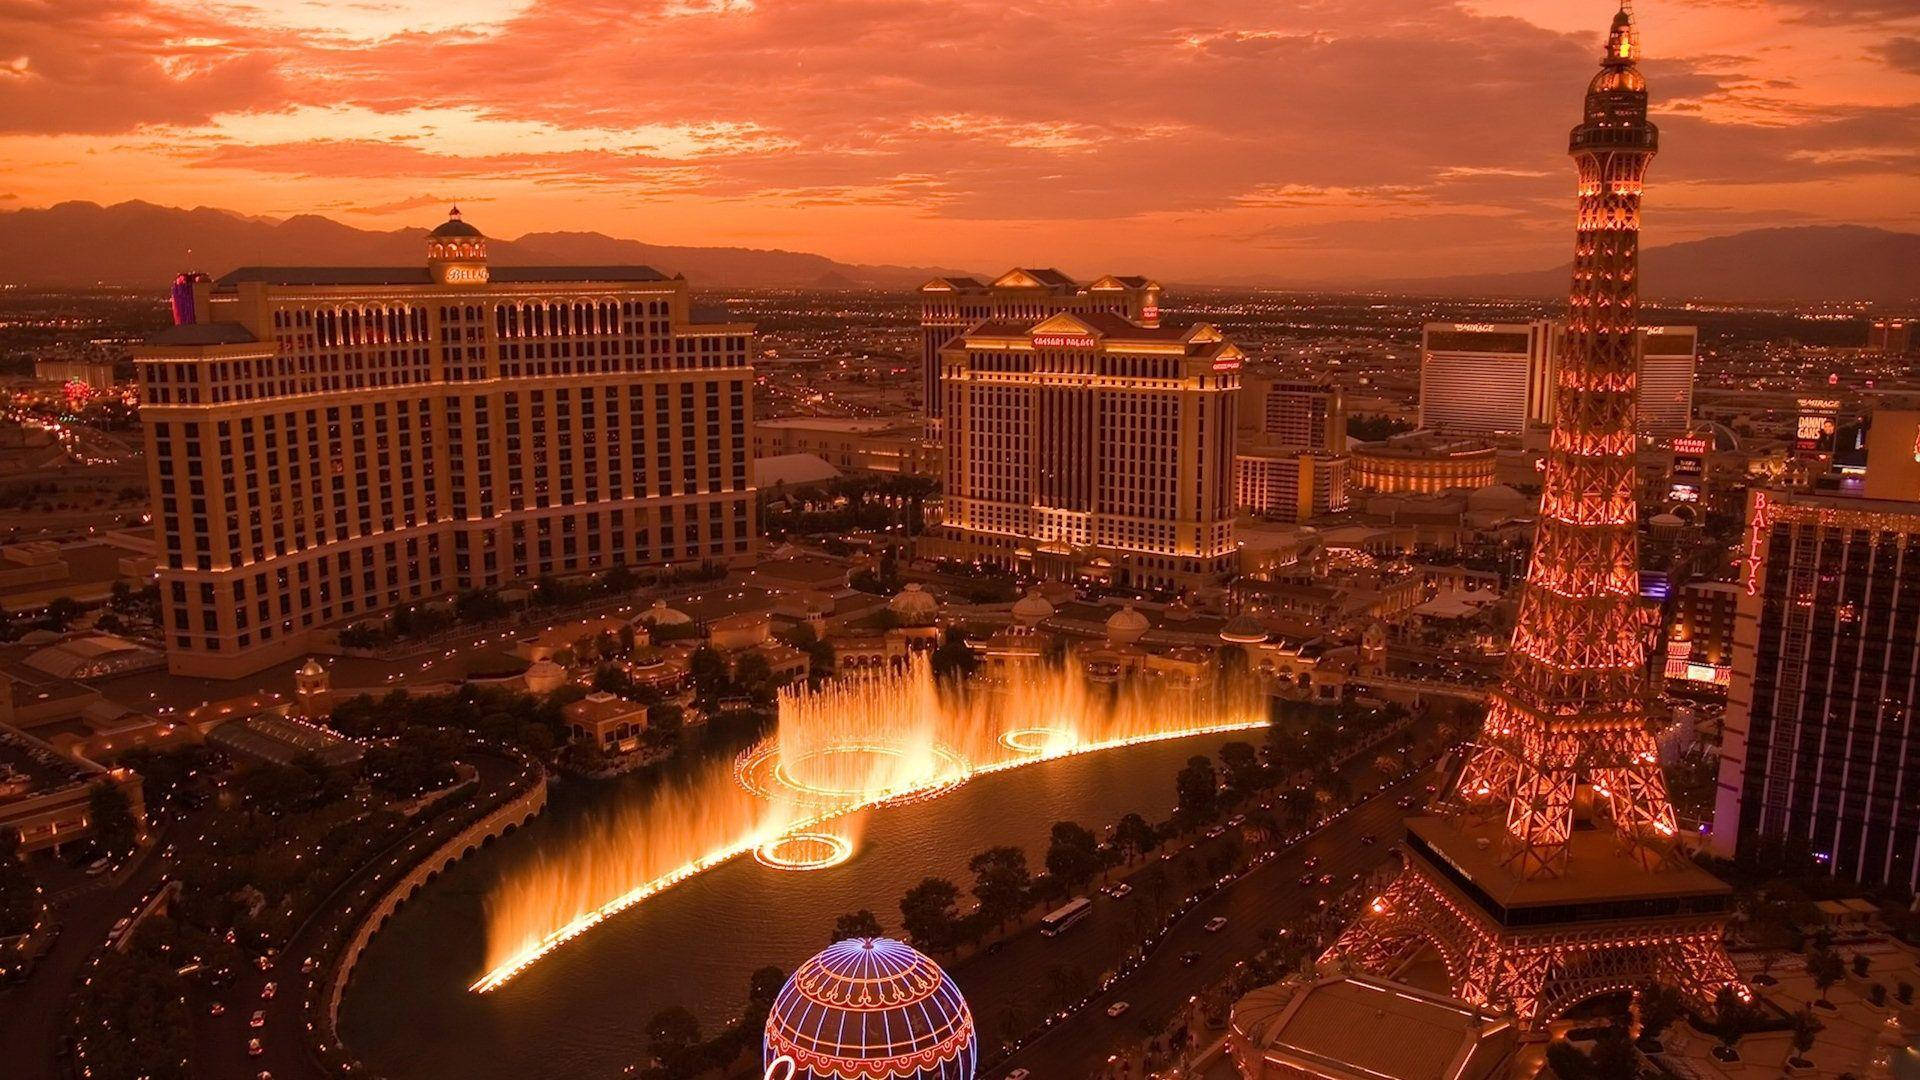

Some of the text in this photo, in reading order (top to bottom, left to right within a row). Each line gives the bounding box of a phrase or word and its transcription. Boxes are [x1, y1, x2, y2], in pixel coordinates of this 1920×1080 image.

[1462, 322, 1495, 333] MIRAGE
[1033, 337, 1094, 347] CAESARS PALACE
[1806, 399, 1841, 408] MIRAGE
[1797, 416, 1827, 429] DANNY
[1797, 427, 1821, 439] GANS
[1673, 438, 1706, 447] CAESARS
[1674, 445, 1705, 454] PALACE
